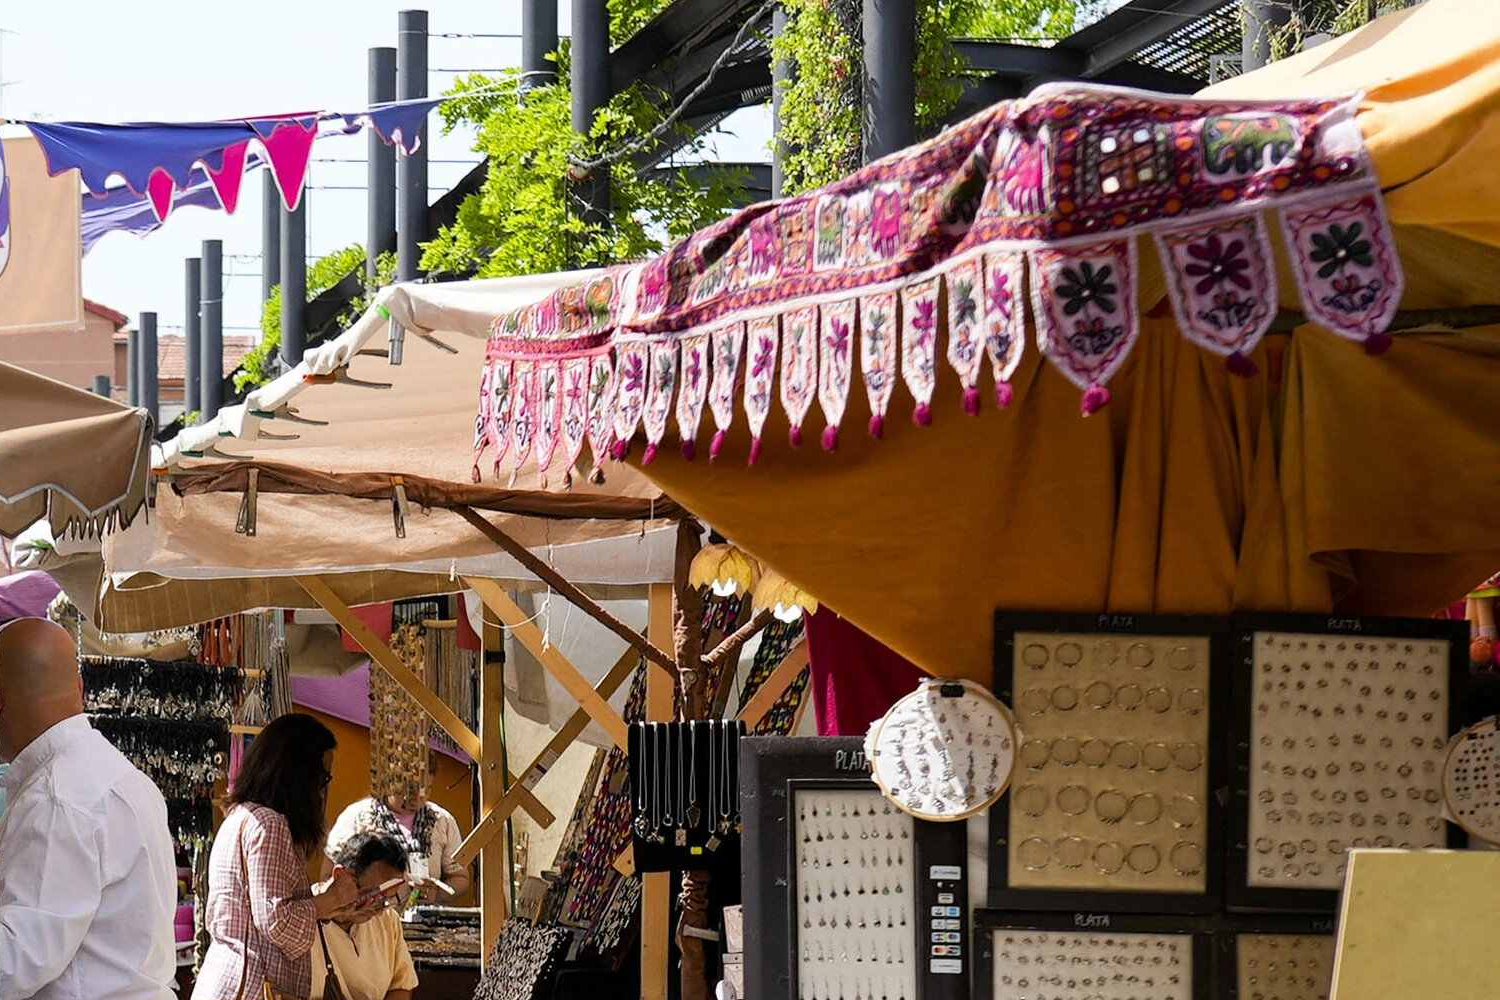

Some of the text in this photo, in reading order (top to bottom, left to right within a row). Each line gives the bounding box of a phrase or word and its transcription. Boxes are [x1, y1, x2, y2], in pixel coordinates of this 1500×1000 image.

[1097, 613, 1133, 628] PLATA
[1326, 617, 1362, 632] PLATA
[1074, 912, 1110, 928] PLATA
